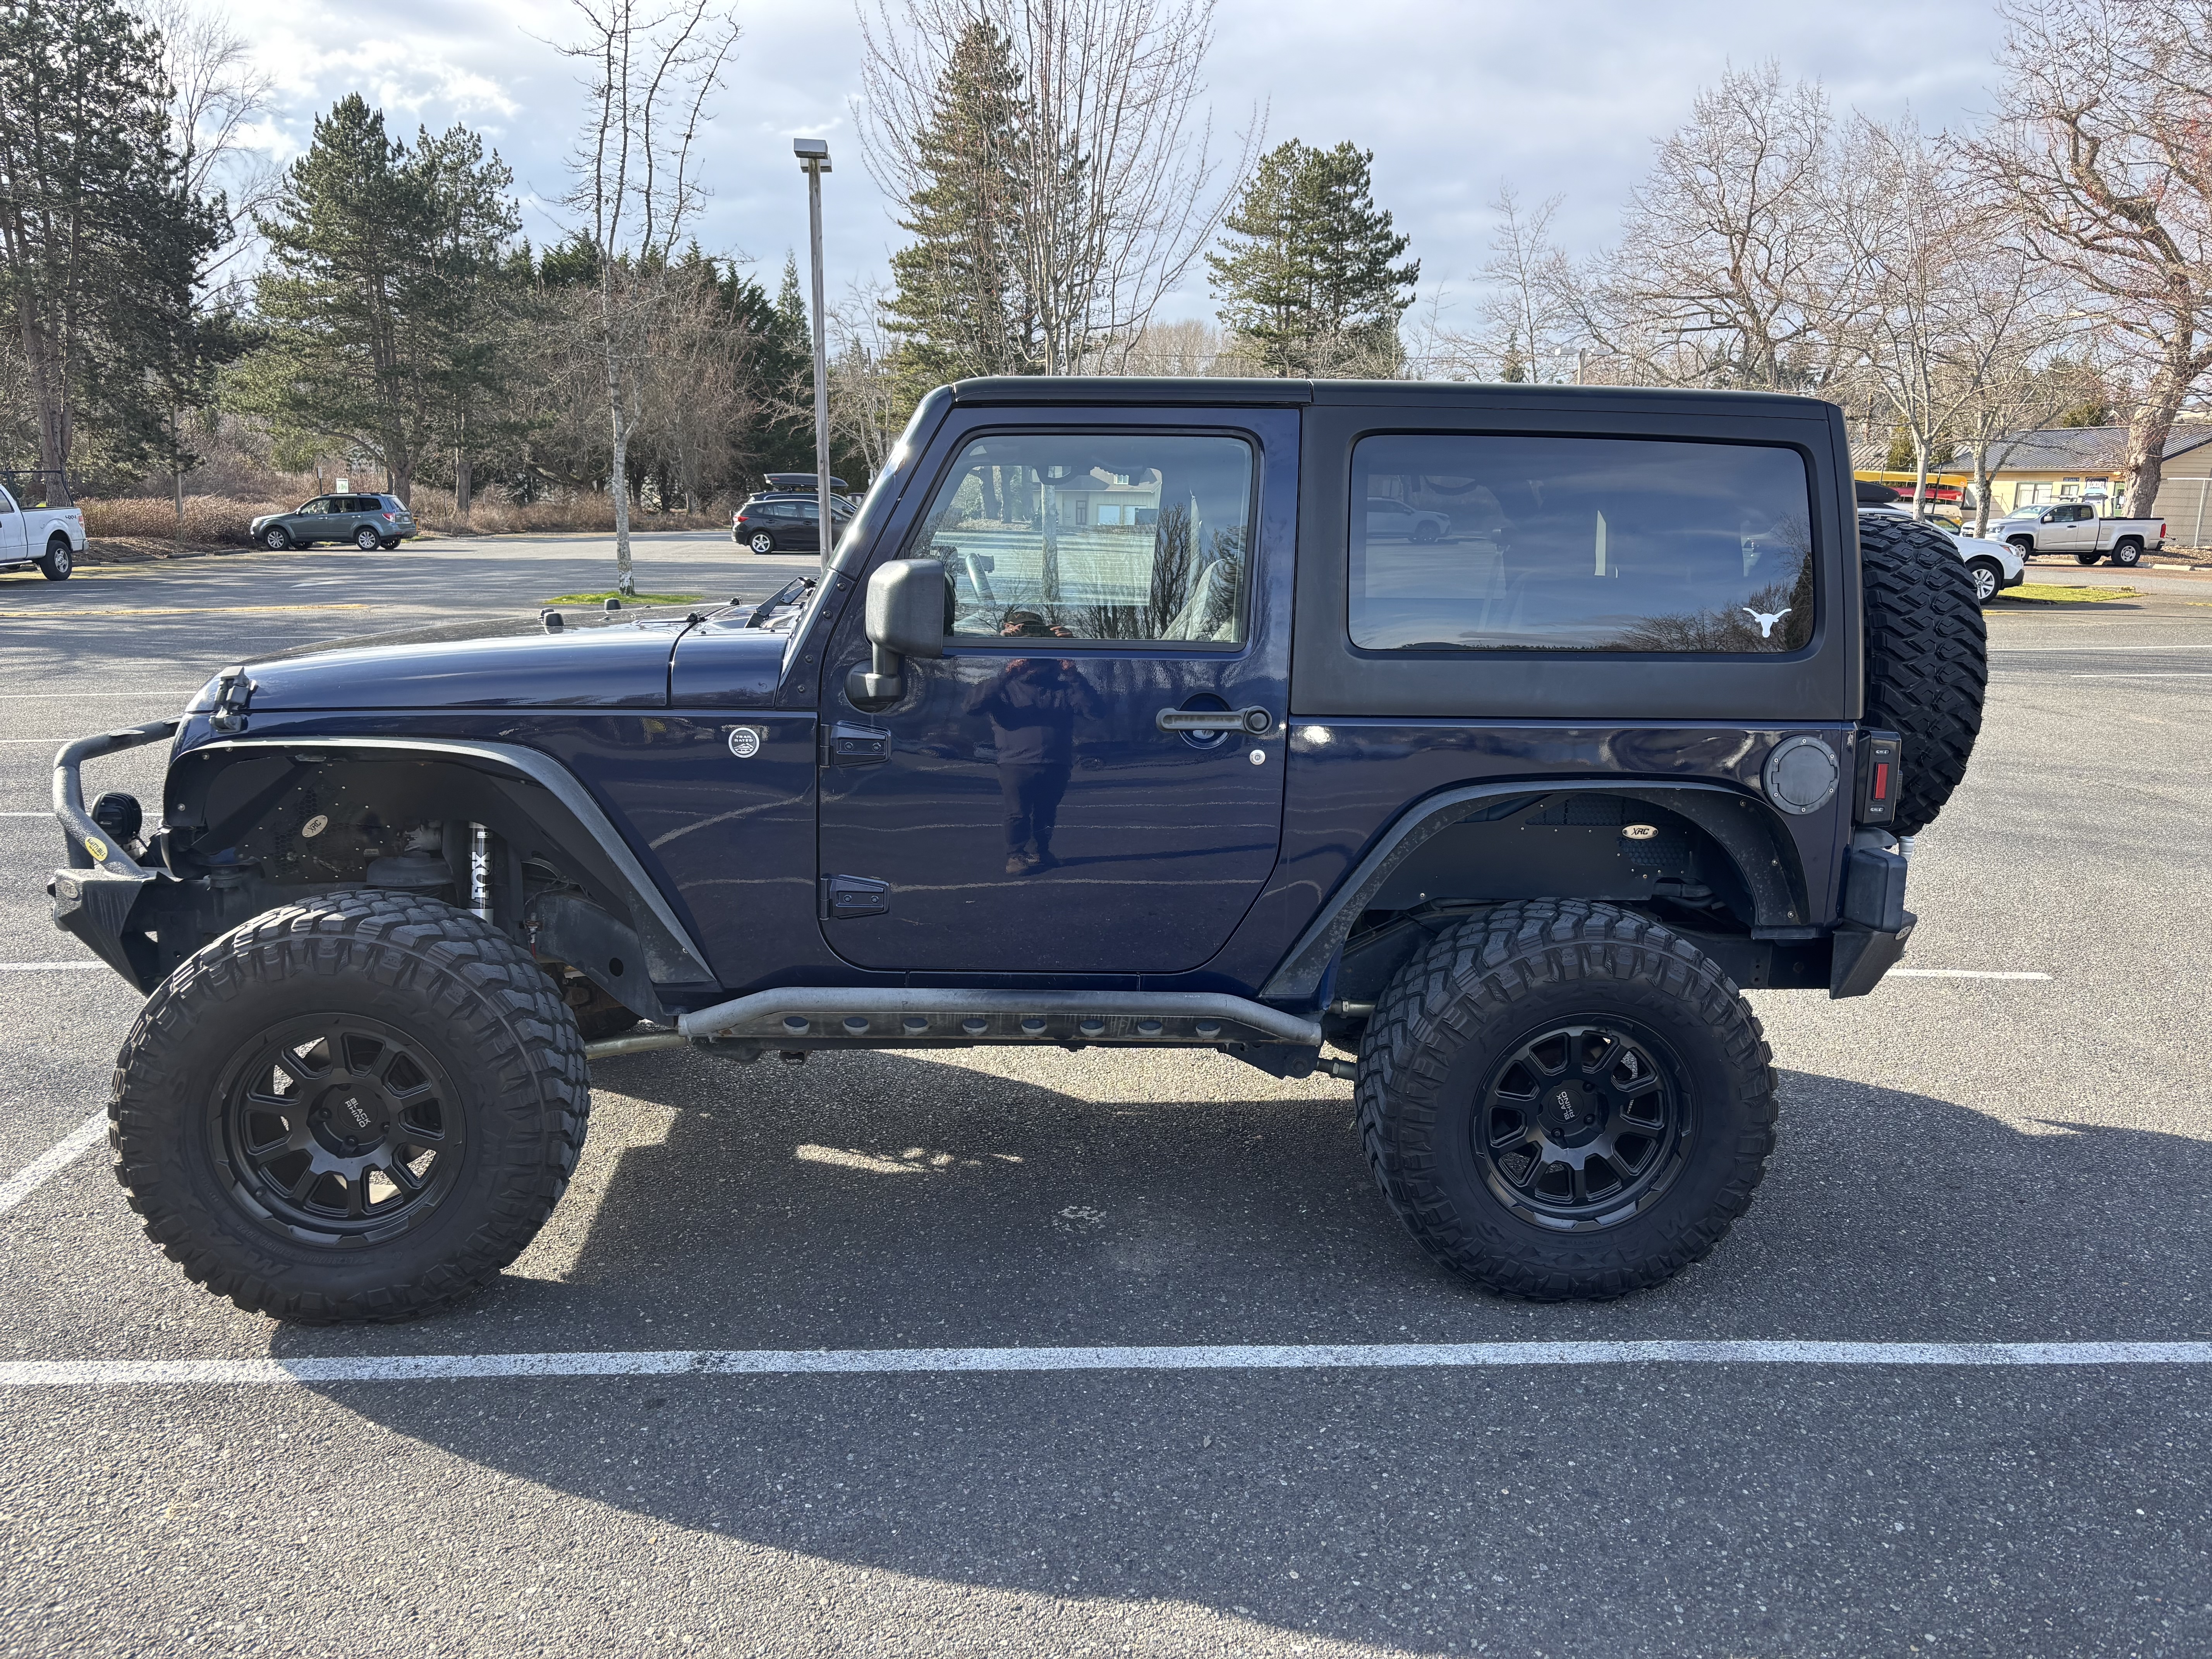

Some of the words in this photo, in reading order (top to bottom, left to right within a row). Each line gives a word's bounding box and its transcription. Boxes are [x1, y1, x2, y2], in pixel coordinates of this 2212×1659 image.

[307, 819, 321, 833] XRC
[471, 851, 492, 900] FOX
[345, 1100, 366, 1128] RHINO
[350, 1097, 371, 1125] BLACK
[1556, 1094, 1570, 1120] BLACK
[1561, 1091, 1575, 1118] RHINO
